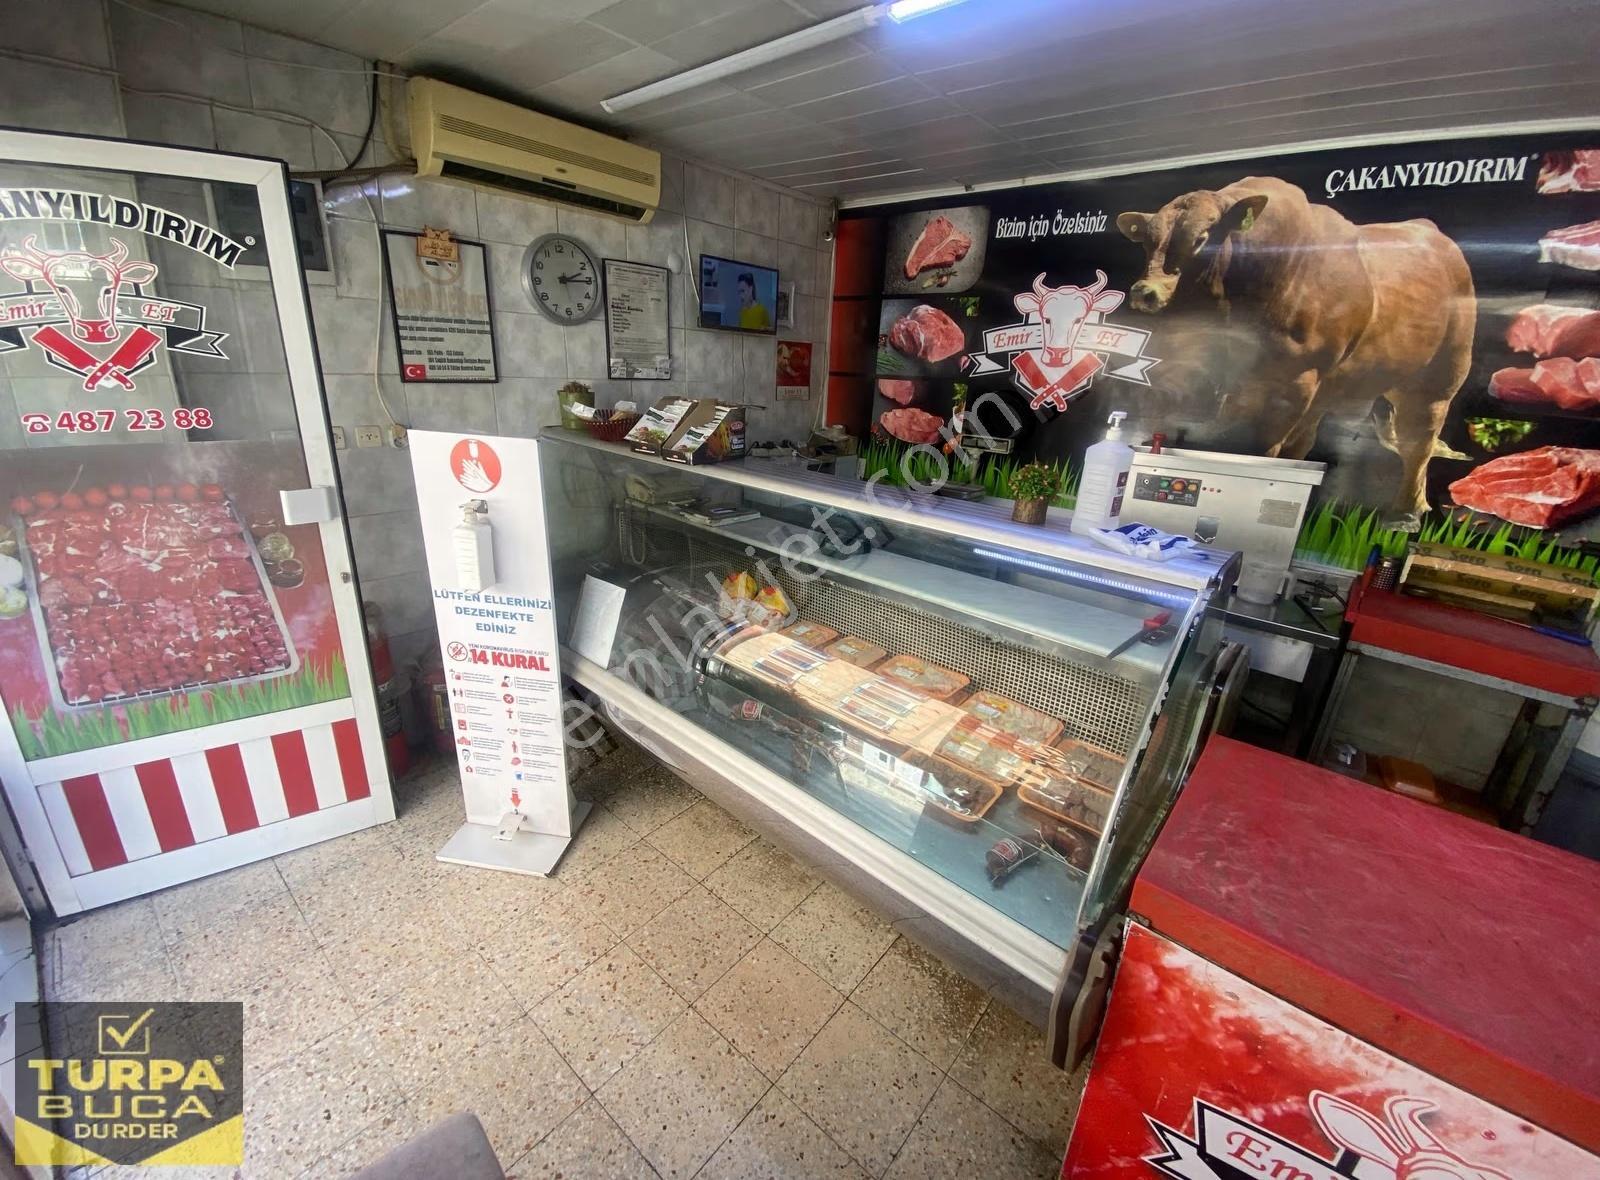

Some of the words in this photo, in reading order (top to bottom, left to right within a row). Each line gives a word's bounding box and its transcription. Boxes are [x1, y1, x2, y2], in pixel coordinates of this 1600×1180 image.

[1325, 156, 1529, 199] ÇAKANYILDIRIM
[995, 217, 1027, 239] Bizim
[1027, 214, 1050, 242] için
[1052, 209, 1109, 236] Özelsiniz
[554, 244, 564, 254] 12
[536, 261, 544, 270] 10
[579, 262, 586, 270] 2
[534, 276, 542, 285] 9
[585, 276, 592, 285] 3
[540, 292, 549, 301] 8
[142, 303, 181, 322] ET
[552, 303, 558, 312] 7
[566, 308, 572, 316] 6
[576, 303, 584, 311] 5
[993, 328, 1033, 349] Emir
[1096, 331, 1128, 347] ET
[56, 410, 116, 433] 487
[124, 409, 165, 431] 23
[173, 407, 213, 430] 88
[434, 589, 481, 602] LÜTFEN
[484, 595, 552, 610] ELLERİNİZİ
[455, 606, 534, 622] DEZENFEKTE
[475, 622, 517, 635] EDİNİZ
[470, 649, 489, 664] 14
[491, 652, 550, 671] KURAL
